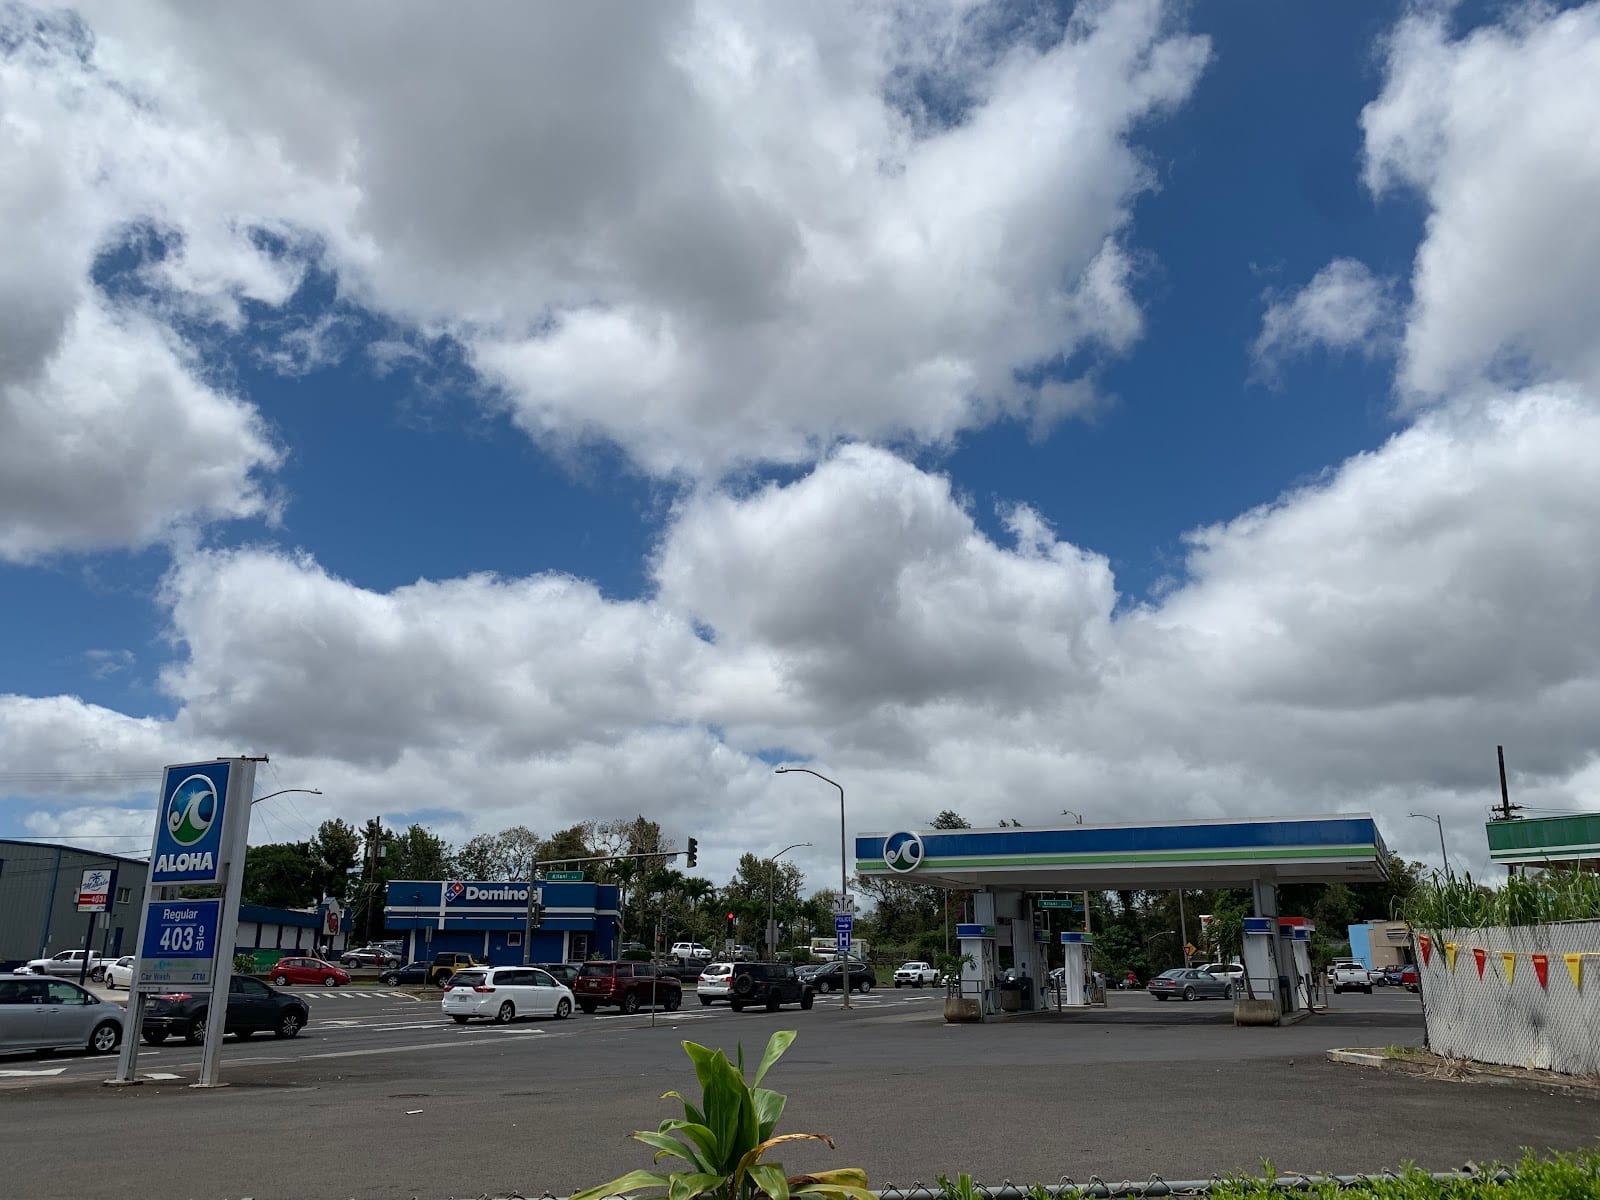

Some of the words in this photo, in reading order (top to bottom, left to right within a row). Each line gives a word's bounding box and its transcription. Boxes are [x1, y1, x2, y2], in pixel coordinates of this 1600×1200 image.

[155, 852, 213, 872] ALOHA
[163, 908, 198, 922] Regular
[160, 926, 194, 951] 403
[195, 940, 205, 951] 10
[839, 932, 849, 946] H
[141, 972, 153, 981] Car
[153, 972, 171, 981] Wash
[191, 972, 206, 981] ATM
